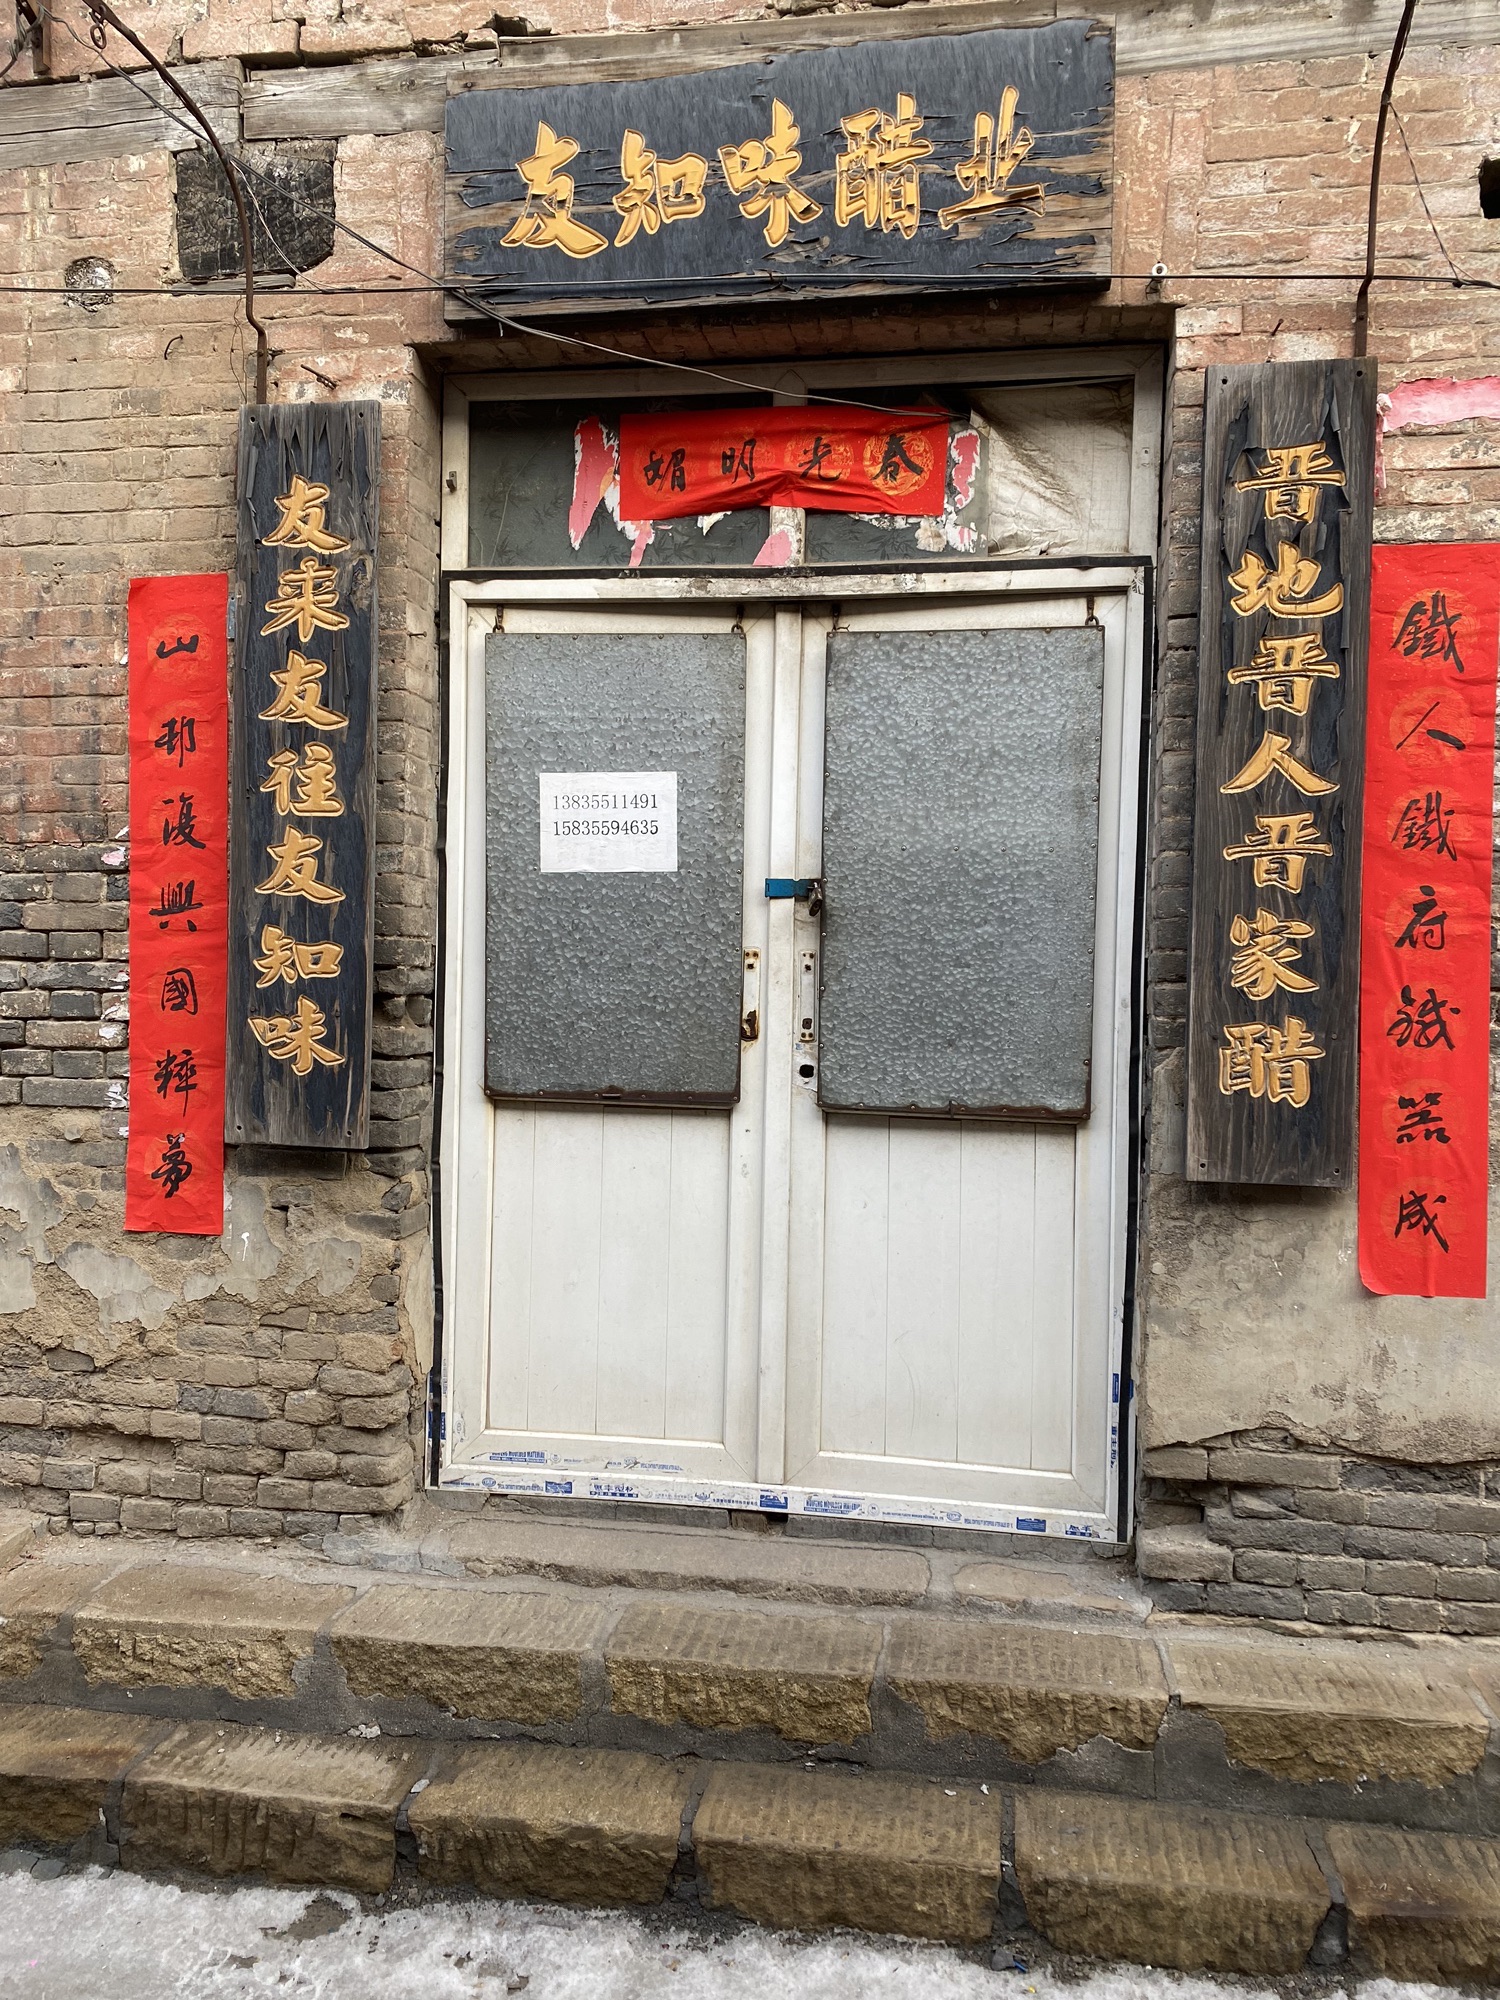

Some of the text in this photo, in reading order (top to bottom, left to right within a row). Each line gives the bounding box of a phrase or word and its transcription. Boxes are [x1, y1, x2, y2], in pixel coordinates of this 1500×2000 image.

[500, 85, 1046, 259] 友知味醋业
[247, 474, 350, 1076] 友来友往友知味
[553, 794, 659, 811] 13835511491
[553, 820, 660, 836] 15835594635
[1219, 441, 1345, 1107] 晋地晋人晋家醋
